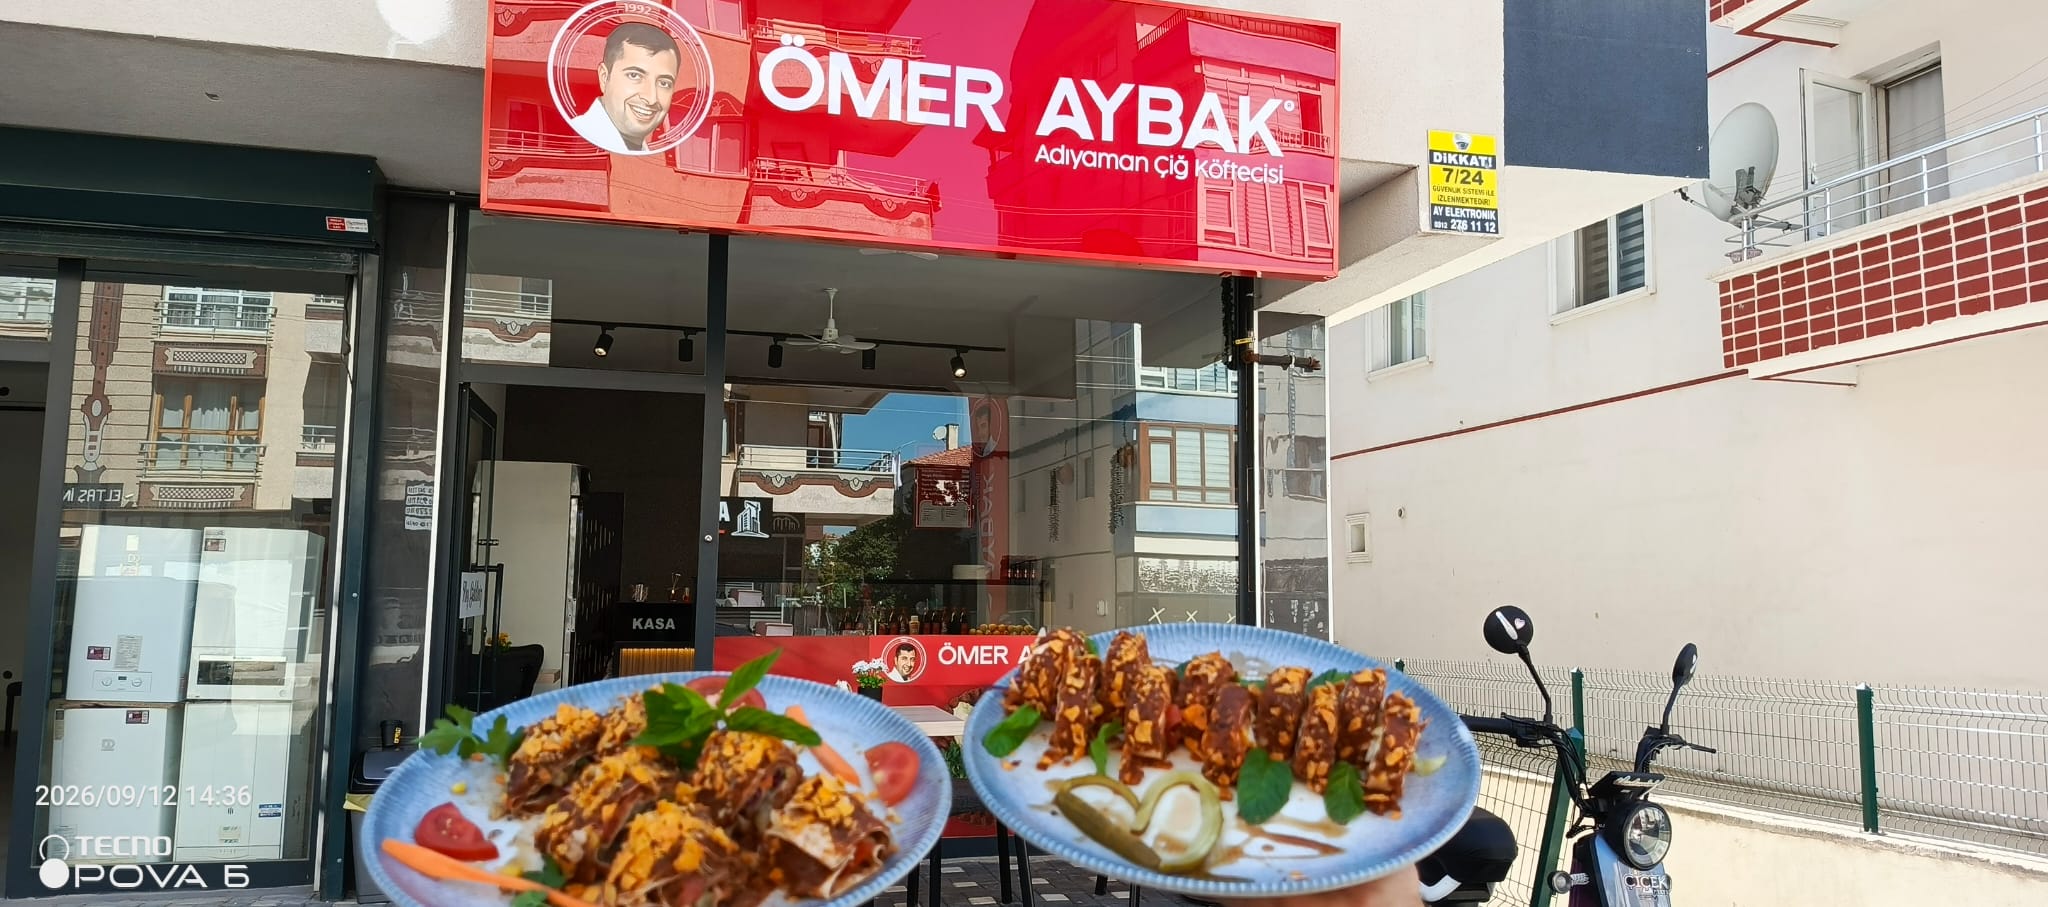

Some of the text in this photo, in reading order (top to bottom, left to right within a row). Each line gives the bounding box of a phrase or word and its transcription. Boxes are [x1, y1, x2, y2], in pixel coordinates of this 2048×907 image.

[622, 2, 652, 16] 1992
[758, 33, 1285, 158] ÖMER AYBAK
[1034, 144, 1284, 185] Adıyaman Çiğ Köftecisi
[1443, 168, 1484, 185] 7/24
[1432, 184, 1461, 194] GÜVENLİK
[1433, 206, 1444, 216] AY
[1433, 219, 1496, 233] 0312 276 11 12
[632, 617, 676, 630] KASA
[938, 642, 1009, 665] ÖMER
